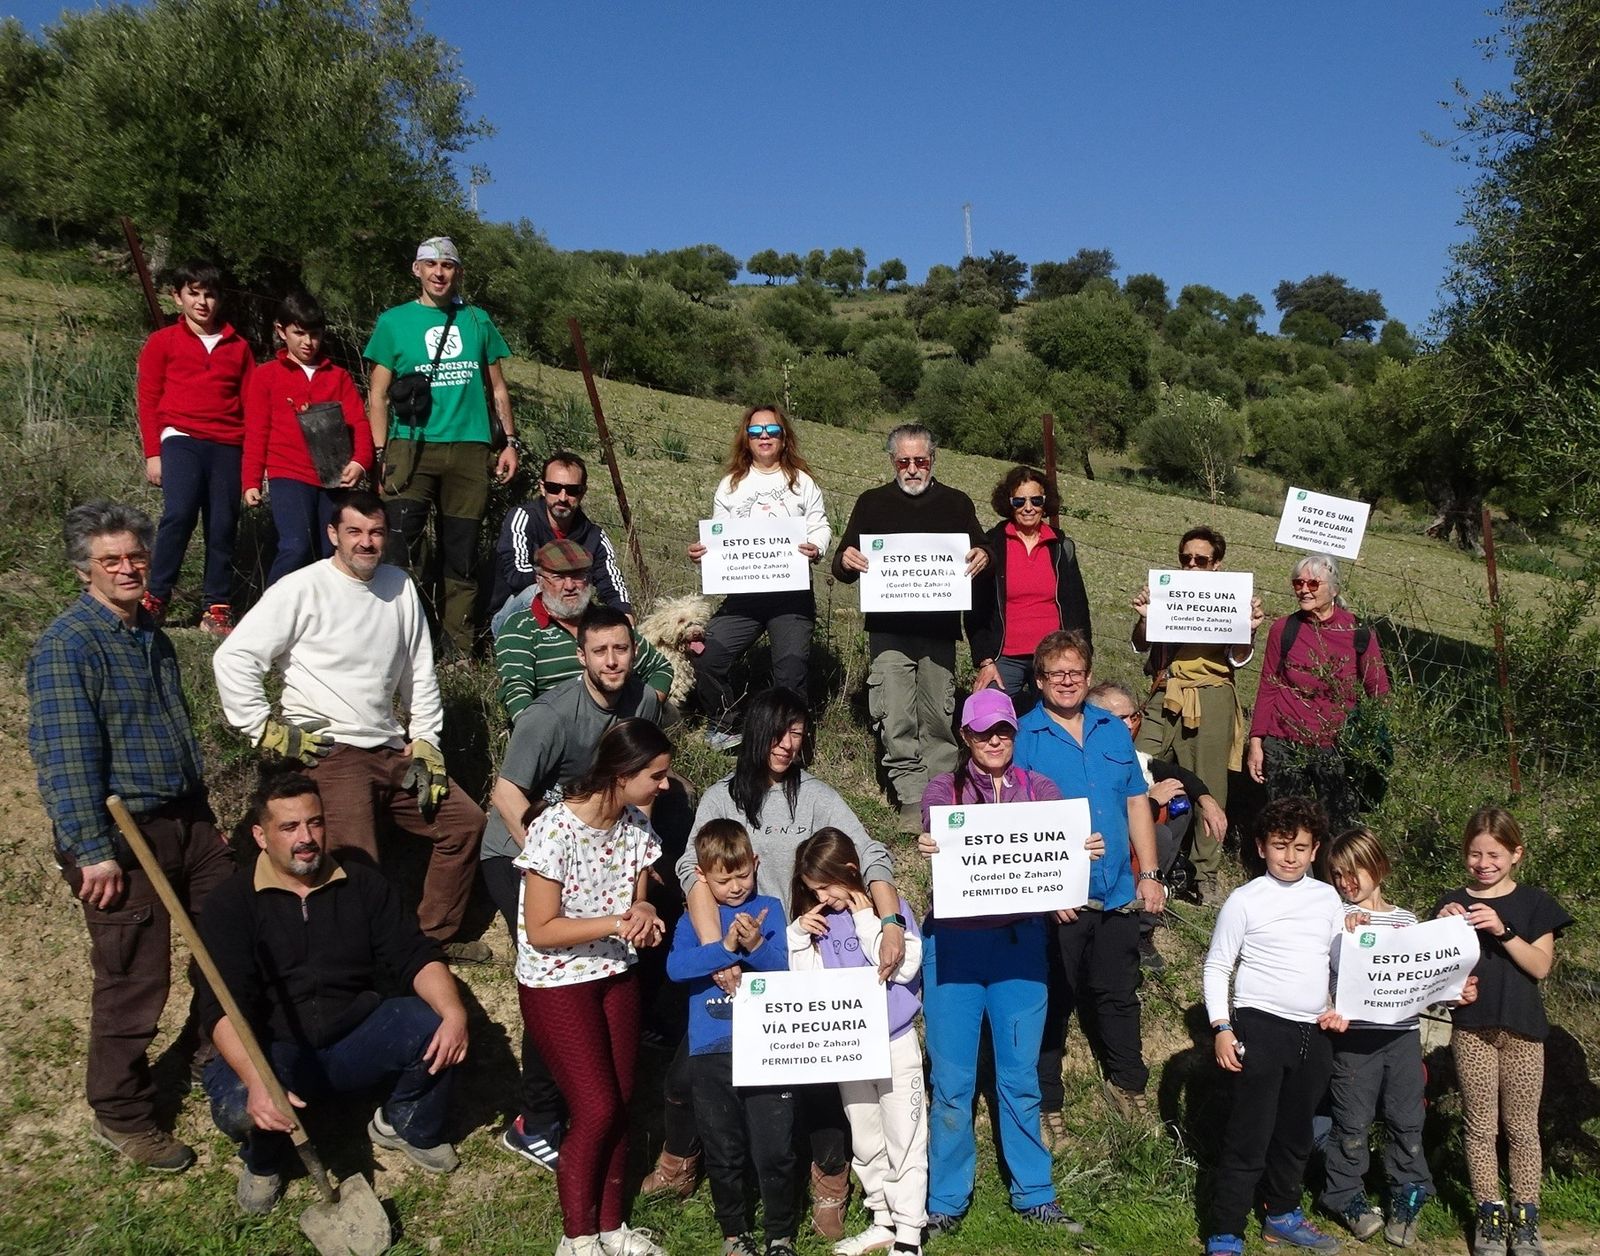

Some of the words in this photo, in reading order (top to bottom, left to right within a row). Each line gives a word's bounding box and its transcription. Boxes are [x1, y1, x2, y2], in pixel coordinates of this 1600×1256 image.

[414, 361, 479, 372] ECOOGISTAS
[1302, 505, 1324, 516] ESTO
[1325, 511, 1336, 519] ES
[1338, 514, 1354, 523] UNA
[1297, 515, 1311, 525] VÍA
[1313, 519, 1353, 534] PECUARIA
[723, 539, 750, 547] ESTO
[753, 538, 766, 546] ES
[769, 537, 791, 545] UNA
[722, 552, 738, 560] VÍA
[883, 555, 911, 563] ESTO
[914, 554, 927, 562] ES
[931, 554, 954, 562] UNA
[881, 568, 899, 577] VÍA
[1169, 590, 1195, 599] ESTO
[1214, 592, 1236, 600] UNA
[1166, 602, 1184, 611] VÍA
[1186, 604, 1237, 613] PECUARIA
[964, 834, 1005, 846] ESTO
[1010, 832, 1028, 844] ES
[1033, 831, 1066, 842] UNA
[961, 853, 987, 866] VÍA
[992, 850, 1070, 865] PECUARIA
[970, 873, 1005, 883] (Cordel
[1009, 872, 1021, 880] De
[1024, 869, 1062, 879] Zahara)
[962, 887, 1018, 897] PERMITIDO
[1021, 886, 1034, 894] EL
[1037, 884, 1064, 893] PASO
[1372, 954, 1410, 964] ESTO
[1415, 951, 1431, 963] ES
[1435, 946, 1461, 960] UNA
[1367, 970, 1392, 982] VÍA
[1397, 963, 1460, 981] PECUARIA
[765, 1002, 803, 1014] ESTO
[808, 1000, 827, 1012] ES
[831, 999, 863, 1011] UNA
[762, 1021, 787, 1034] VÍA
[792, 1018, 867, 1033] PECUARIA
[769, 1041, 805, 1051] (Cordel
[807, 1041, 820, 1049] De
[823, 1038, 861, 1048] Zahara)
[761, 1056, 817, 1066] PERMITIDO
[820, 1055, 832, 1063] EL
[835, 1053, 863, 1062] PASO
